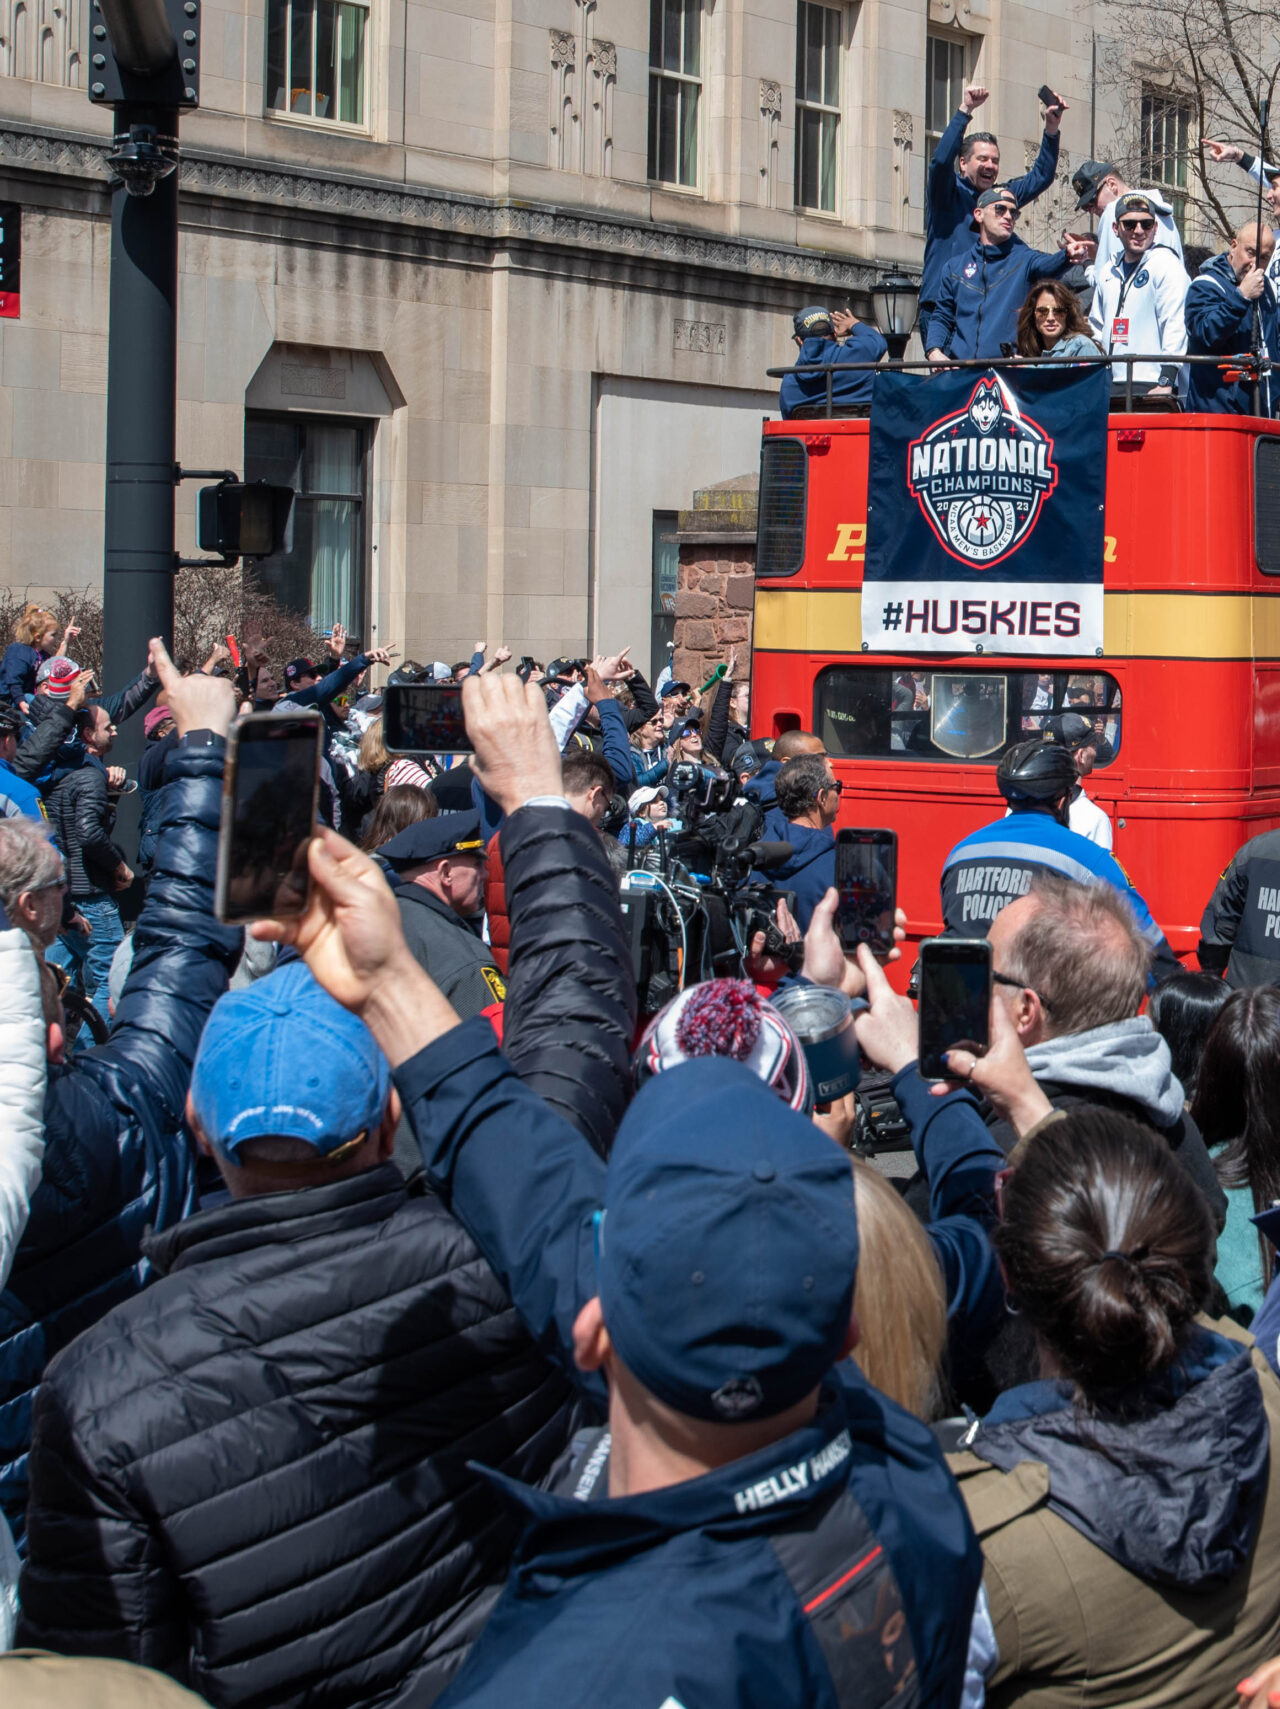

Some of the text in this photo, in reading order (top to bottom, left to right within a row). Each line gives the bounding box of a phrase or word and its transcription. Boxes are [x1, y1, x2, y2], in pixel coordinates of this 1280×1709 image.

[912, 437, 1052, 481] NATIONAL
[931, 475, 1032, 494] CHAMPIONS
[936, 501, 1029, 512] 20 23
[949, 504, 1013, 557] NCAA MEN'S BASKETBALL
[882, 599, 1081, 638] #HU5KIES
[956, 867, 1033, 895] HARTFORD
[734, 1462, 808, 1514] HELLY
